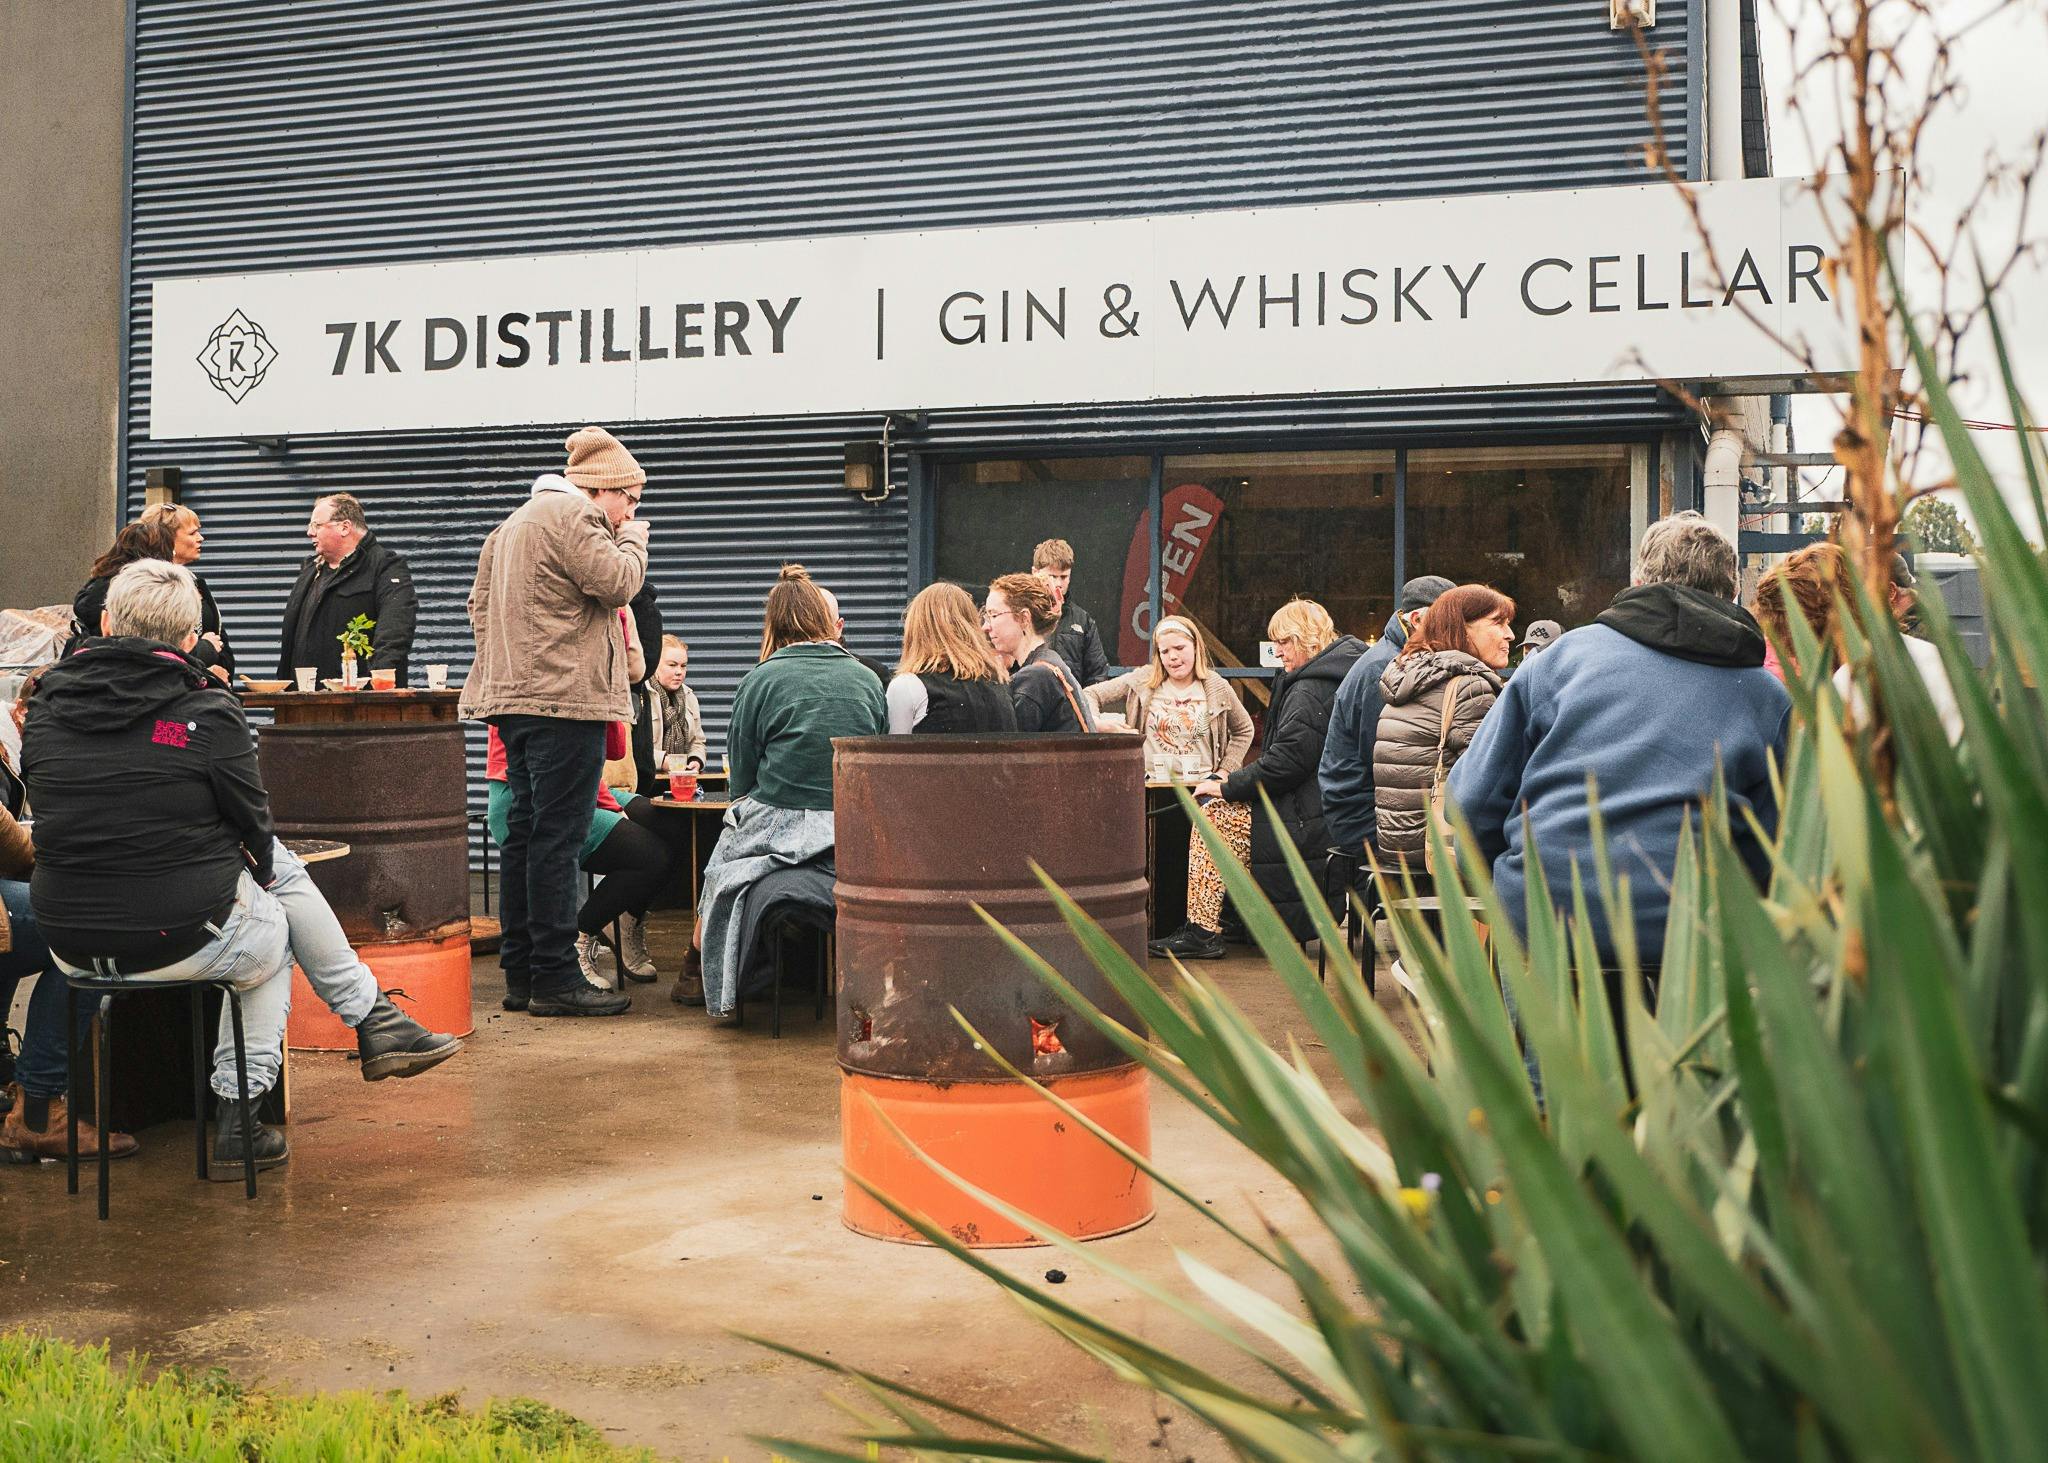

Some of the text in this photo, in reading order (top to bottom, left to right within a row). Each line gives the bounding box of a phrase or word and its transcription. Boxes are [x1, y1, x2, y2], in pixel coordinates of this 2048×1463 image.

[326, 319, 402, 375] 7K
[425, 296, 802, 372] DISTILLERY
[938, 287, 1066, 346] GIN
[1099, 284, 1140, 339] &
[1169, 262, 1487, 332] WHISKY
[1520, 244, 1830, 316] CELLAR
